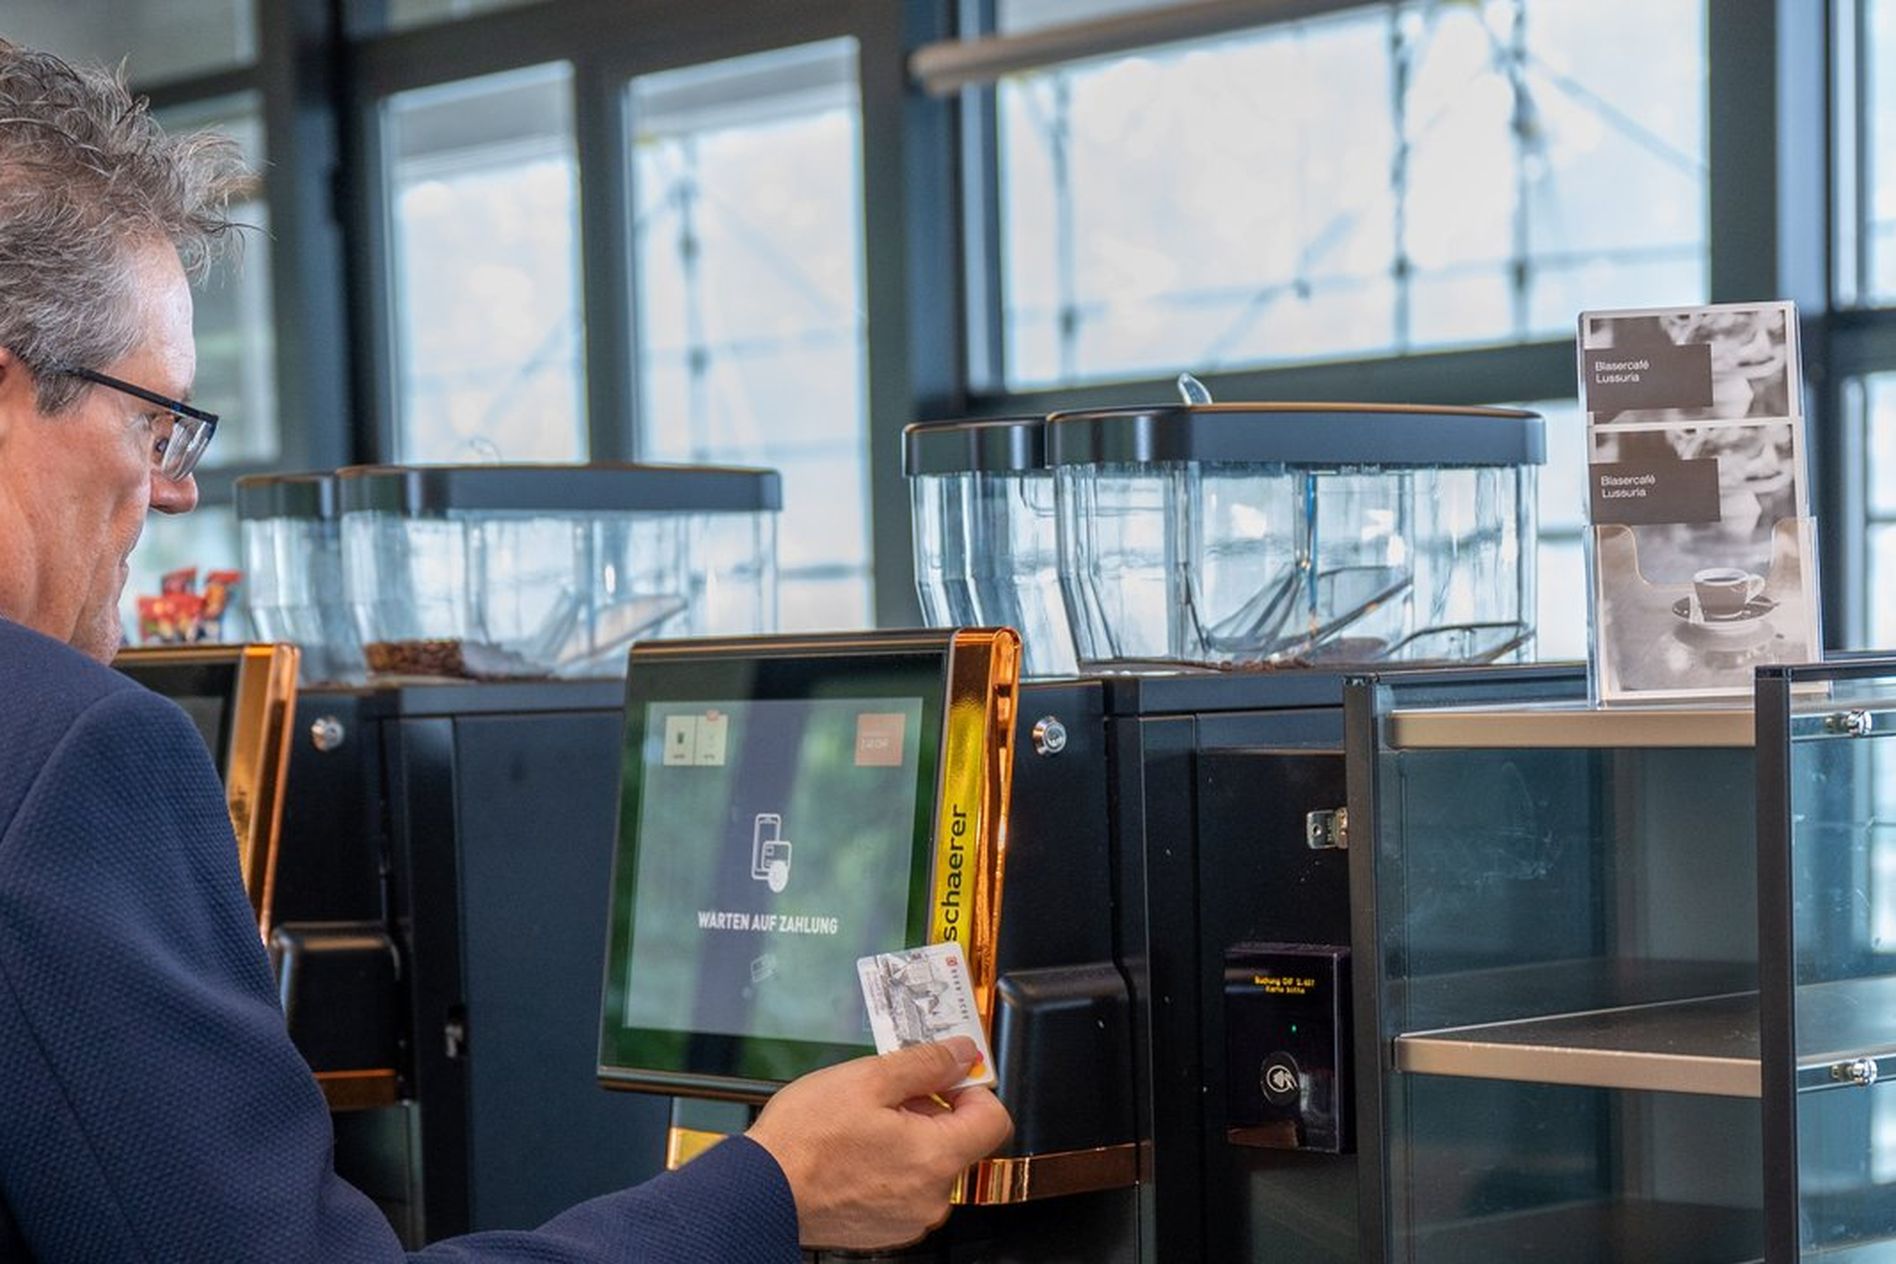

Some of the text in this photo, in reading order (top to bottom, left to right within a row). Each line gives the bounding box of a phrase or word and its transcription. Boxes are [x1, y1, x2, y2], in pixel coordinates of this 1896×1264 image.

[1595, 360, 1650, 371] Blasercafé
[1596, 373, 1640, 384] Lussuria
[1600, 474, 1656, 486] Blasercafé
[1602, 488, 1647, 498] Lussuria
[941, 804, 967, 942] schaerer
[697, 910, 839, 935] WARTEN AUF ZAHLUNG
